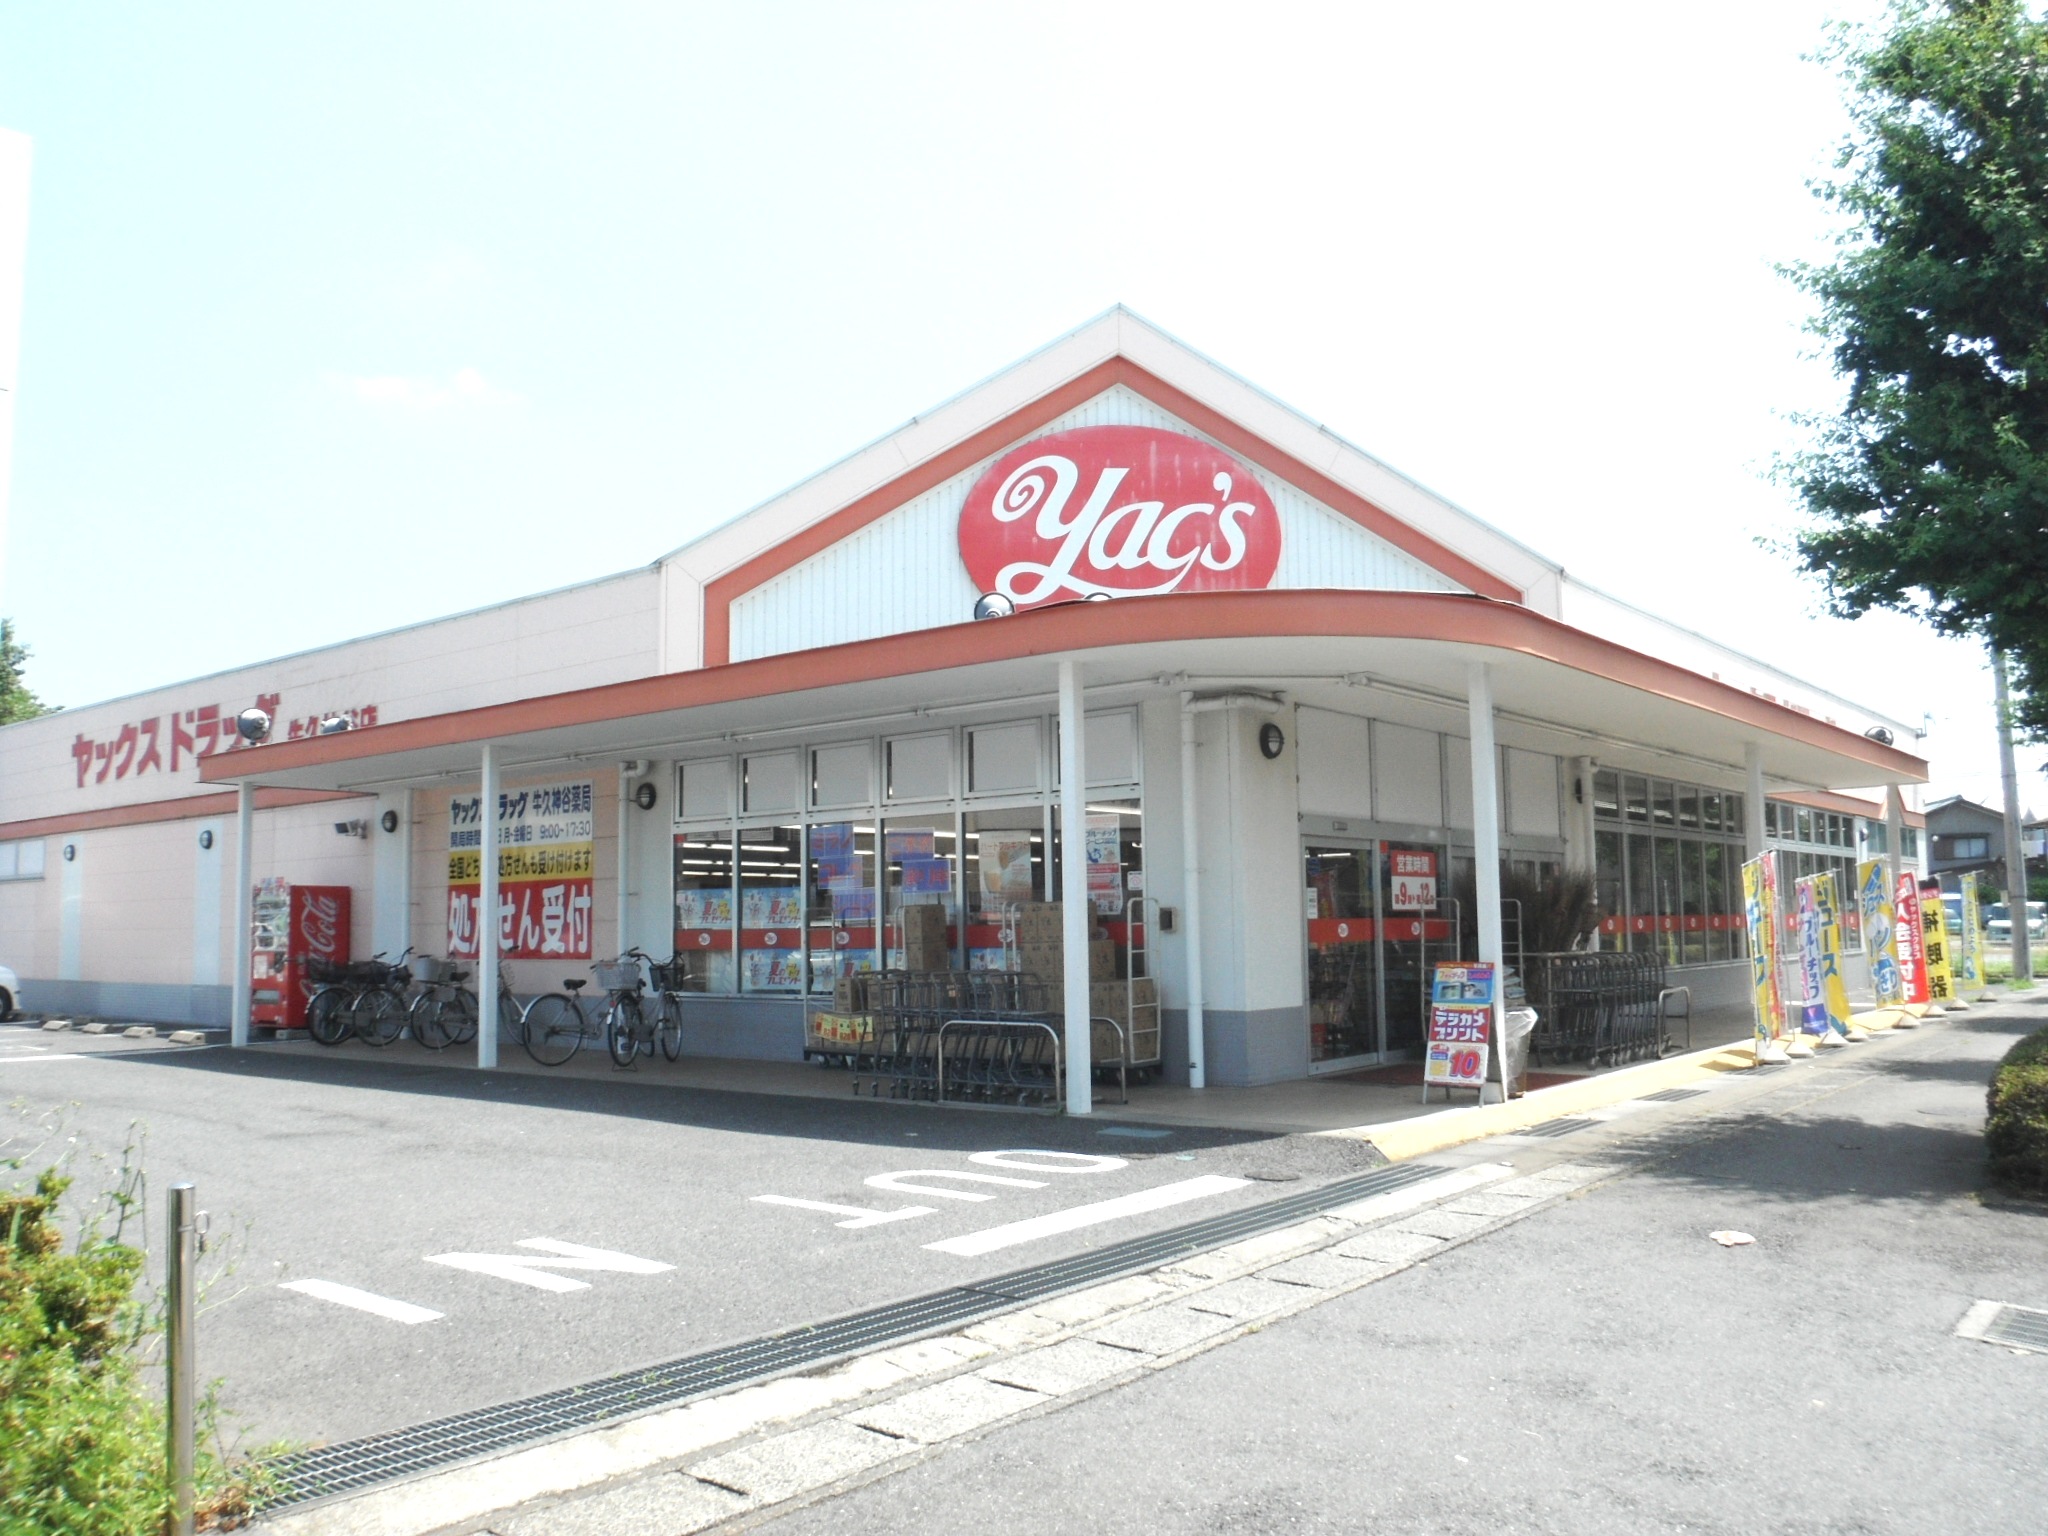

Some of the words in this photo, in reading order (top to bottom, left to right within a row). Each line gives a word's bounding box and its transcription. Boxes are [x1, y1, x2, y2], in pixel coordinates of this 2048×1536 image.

[532, 784, 591, 818] 牛久神谷薬局
[1434, 1010, 1485, 1027] デジカメ
